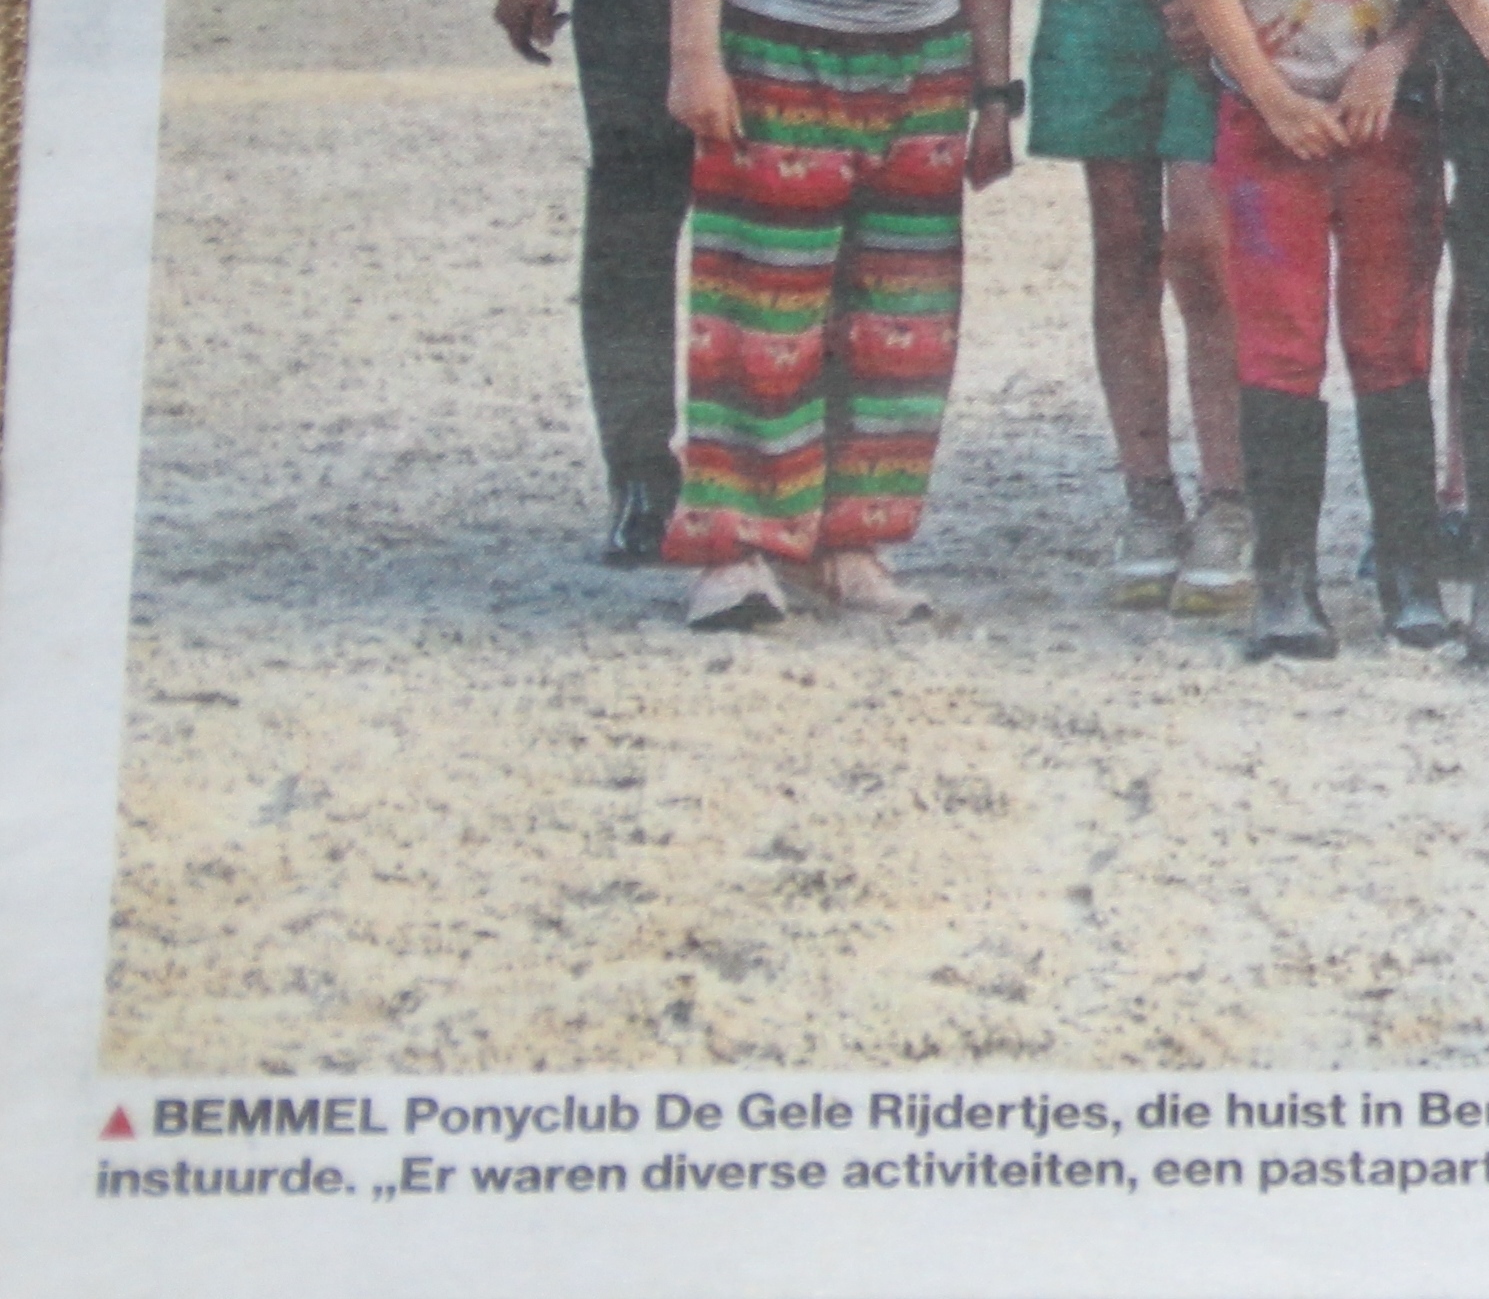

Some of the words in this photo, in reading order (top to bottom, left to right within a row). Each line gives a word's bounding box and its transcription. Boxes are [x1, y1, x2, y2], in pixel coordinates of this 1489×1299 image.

[154, 1097, 387, 1135] BEMMEL
[406, 1094, 639, 1140] Ponyclub
[657, 1093, 722, 1130] De
[739, 1092, 852, 1129] Gele
[870, 1093, 1122, 1137] Rijdertjes,
[1137, 1093, 1210, 1128] die
[1227, 1093, 1345, 1127] huist
[1362, 1093, 1402, 1126] in
[98, 1158, 355, 1196] instuurde.
[472, 1164, 627, 1192] waren
[642, 1153, 826, 1190] diverse
[844, 1151, 1137, 1192] activiteiten,
[1153, 1159, 1243, 1185] een
